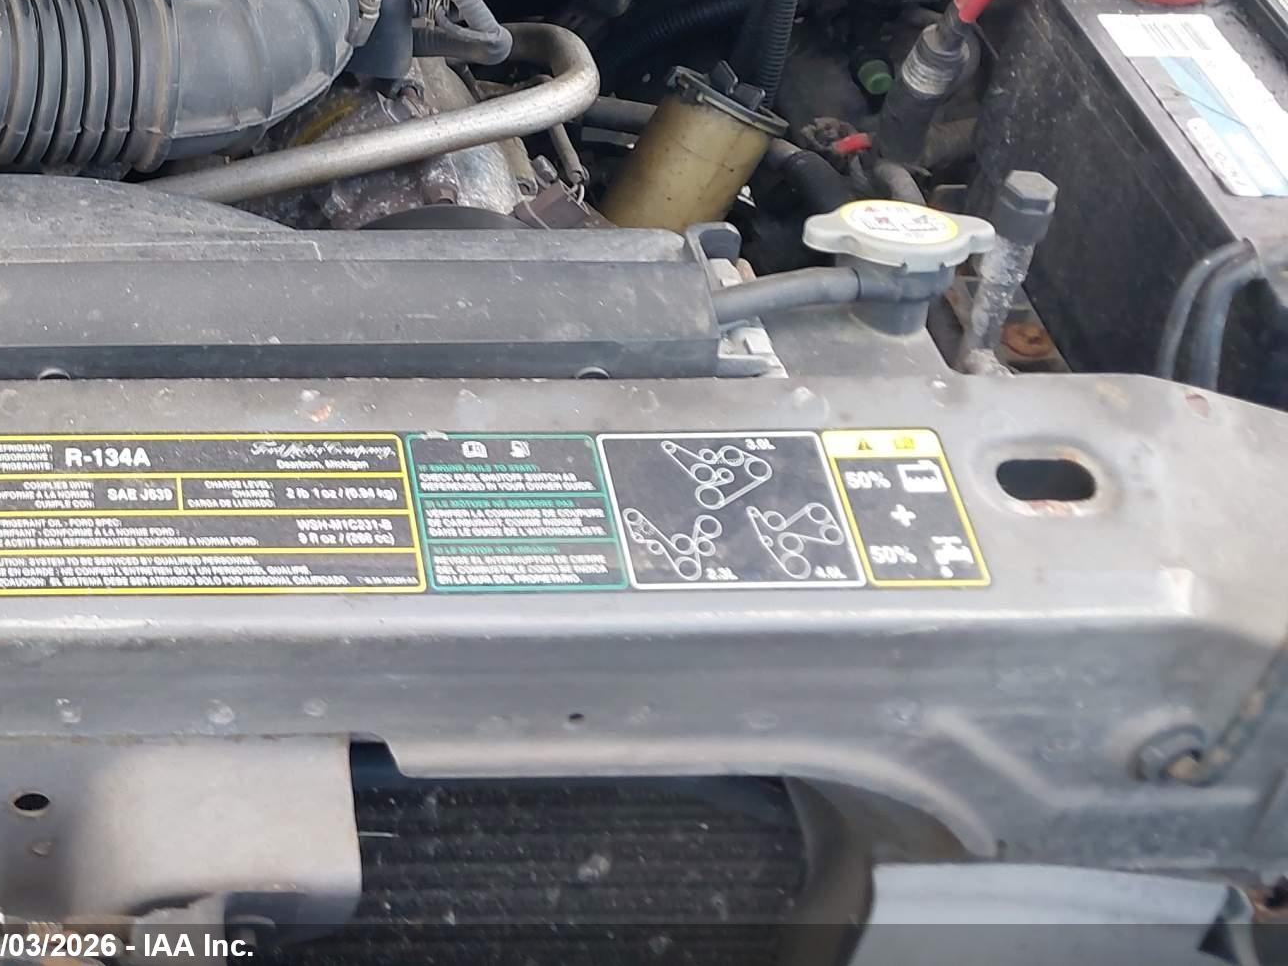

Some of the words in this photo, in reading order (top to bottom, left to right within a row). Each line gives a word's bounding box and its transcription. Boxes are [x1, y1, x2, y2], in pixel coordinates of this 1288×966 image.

[744, 438, 776, 451] 3.0L
[64, 446, 151, 468] R-134A
[324, 460, 369, 470] Michigan
[494, 464, 508, 472] TO
[453, 473, 481, 482] FUEL
[845, 471, 892, 488] 50%
[23, 481, 69, 490] COMPLIES
[203, 480, 242, 489] CHARGE
[485, 482, 499, 491] IN
[497, 481, 526, 491] YOUR
[107, 488, 137, 501] SAE
[140, 488, 173, 501] J639
[232, 489, 270, 498] CHARGE
[295, 487, 311, 499] lb
[311, 487, 320, 499] 1
[320, 488, 338, 499] oz
[375, 487, 398, 501] kg)
[34, 499, 72, 509] CUMPLE
[187, 498, 220, 508] CARGA
[218, 498, 233, 508] DE
[540, 508, 557, 518] DE
[47, 518, 63, 528] OIL
[68, 518, 94, 527] FORD
[42, 528, 93, 538] CONFORME
[149, 527, 175, 537] FORD
[503, 527, 520, 537] DE
[37, 537, 64, 547] PARA
[137, 537, 188, 546] CONFORME
[320, 534, 338, 544] oz
[552, 555, 570, 564] DE
[869, 545, 918, 564] 50%
[28, 557, 67, 567] SYSTEM
[66, 557, 81, 566] TO
[79, 557, 94, 566] BE
[93, 556, 140, 566] SERVICED
[139, 556, 154, 566] BY
[153, 556, 202, 566] QUALIFIED
[7, 567, 22, 576] EN
[21, 567, 55, 576] GARDE
[59, 567, 75, 576] NE
[195, 565, 213, 575] UN
[211, 565, 268, 575] PERSONNEL
[49, 577, 64, 587] EL
[128, 576, 149, 586] SER
[222, 576, 244, 586] POR
